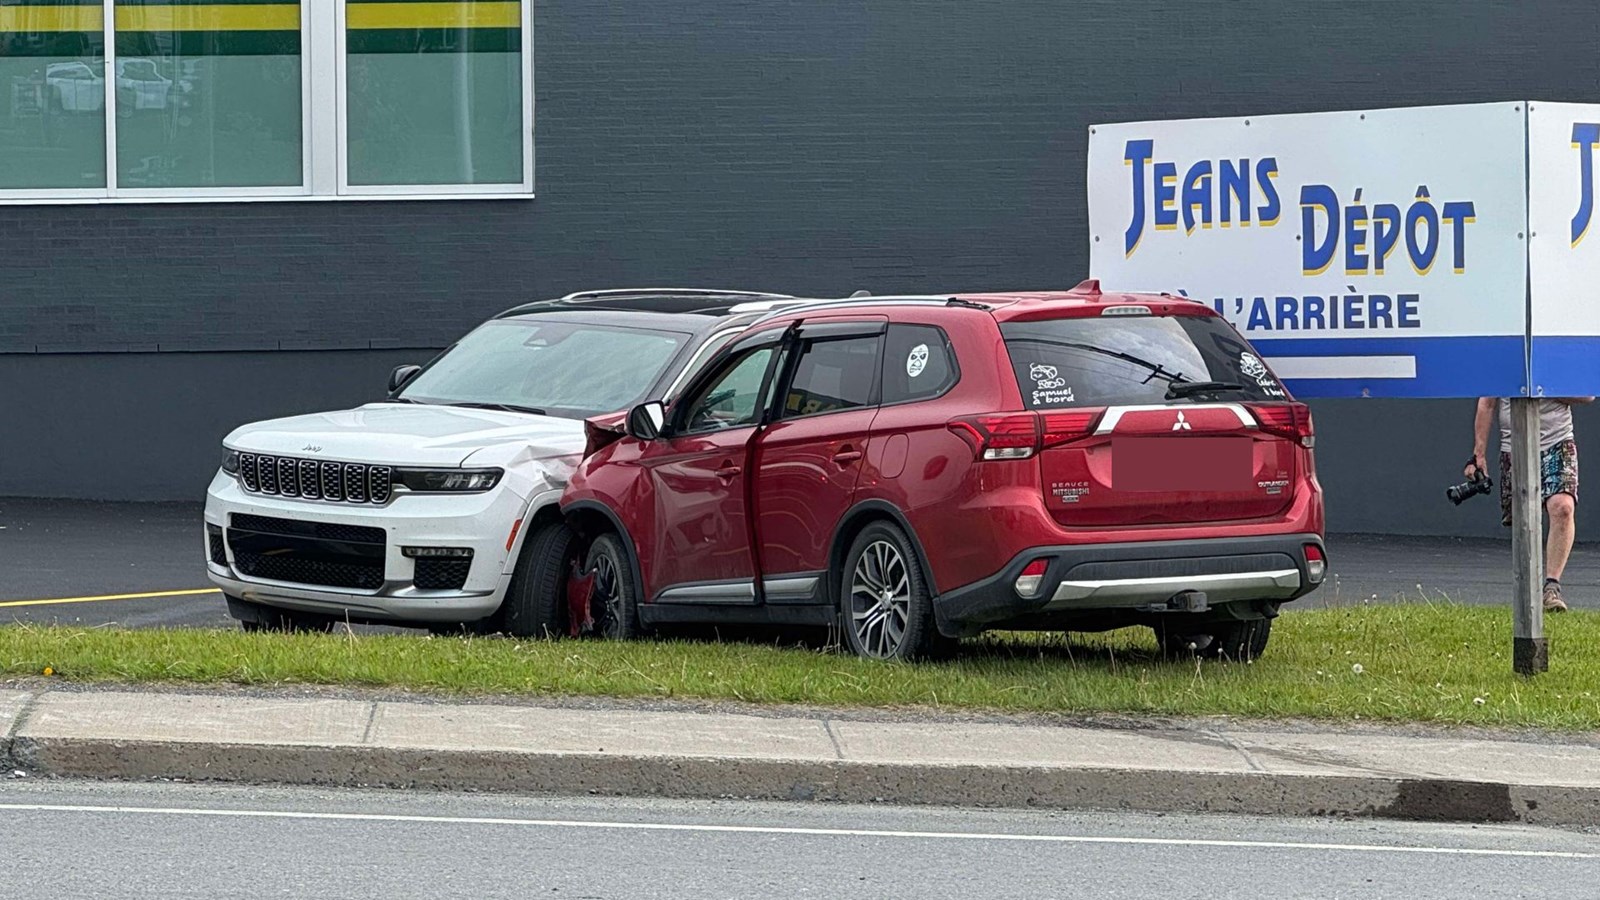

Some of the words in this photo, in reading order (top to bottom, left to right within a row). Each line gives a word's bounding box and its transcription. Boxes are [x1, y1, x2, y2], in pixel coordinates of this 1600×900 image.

[1124, 139, 1281, 260] JEANS
[1300, 185, 1476, 276] DÉPÔT
[1045, 394, 1075, 403] bord
[1052, 487, 1090, 496] MITSUBISHI
